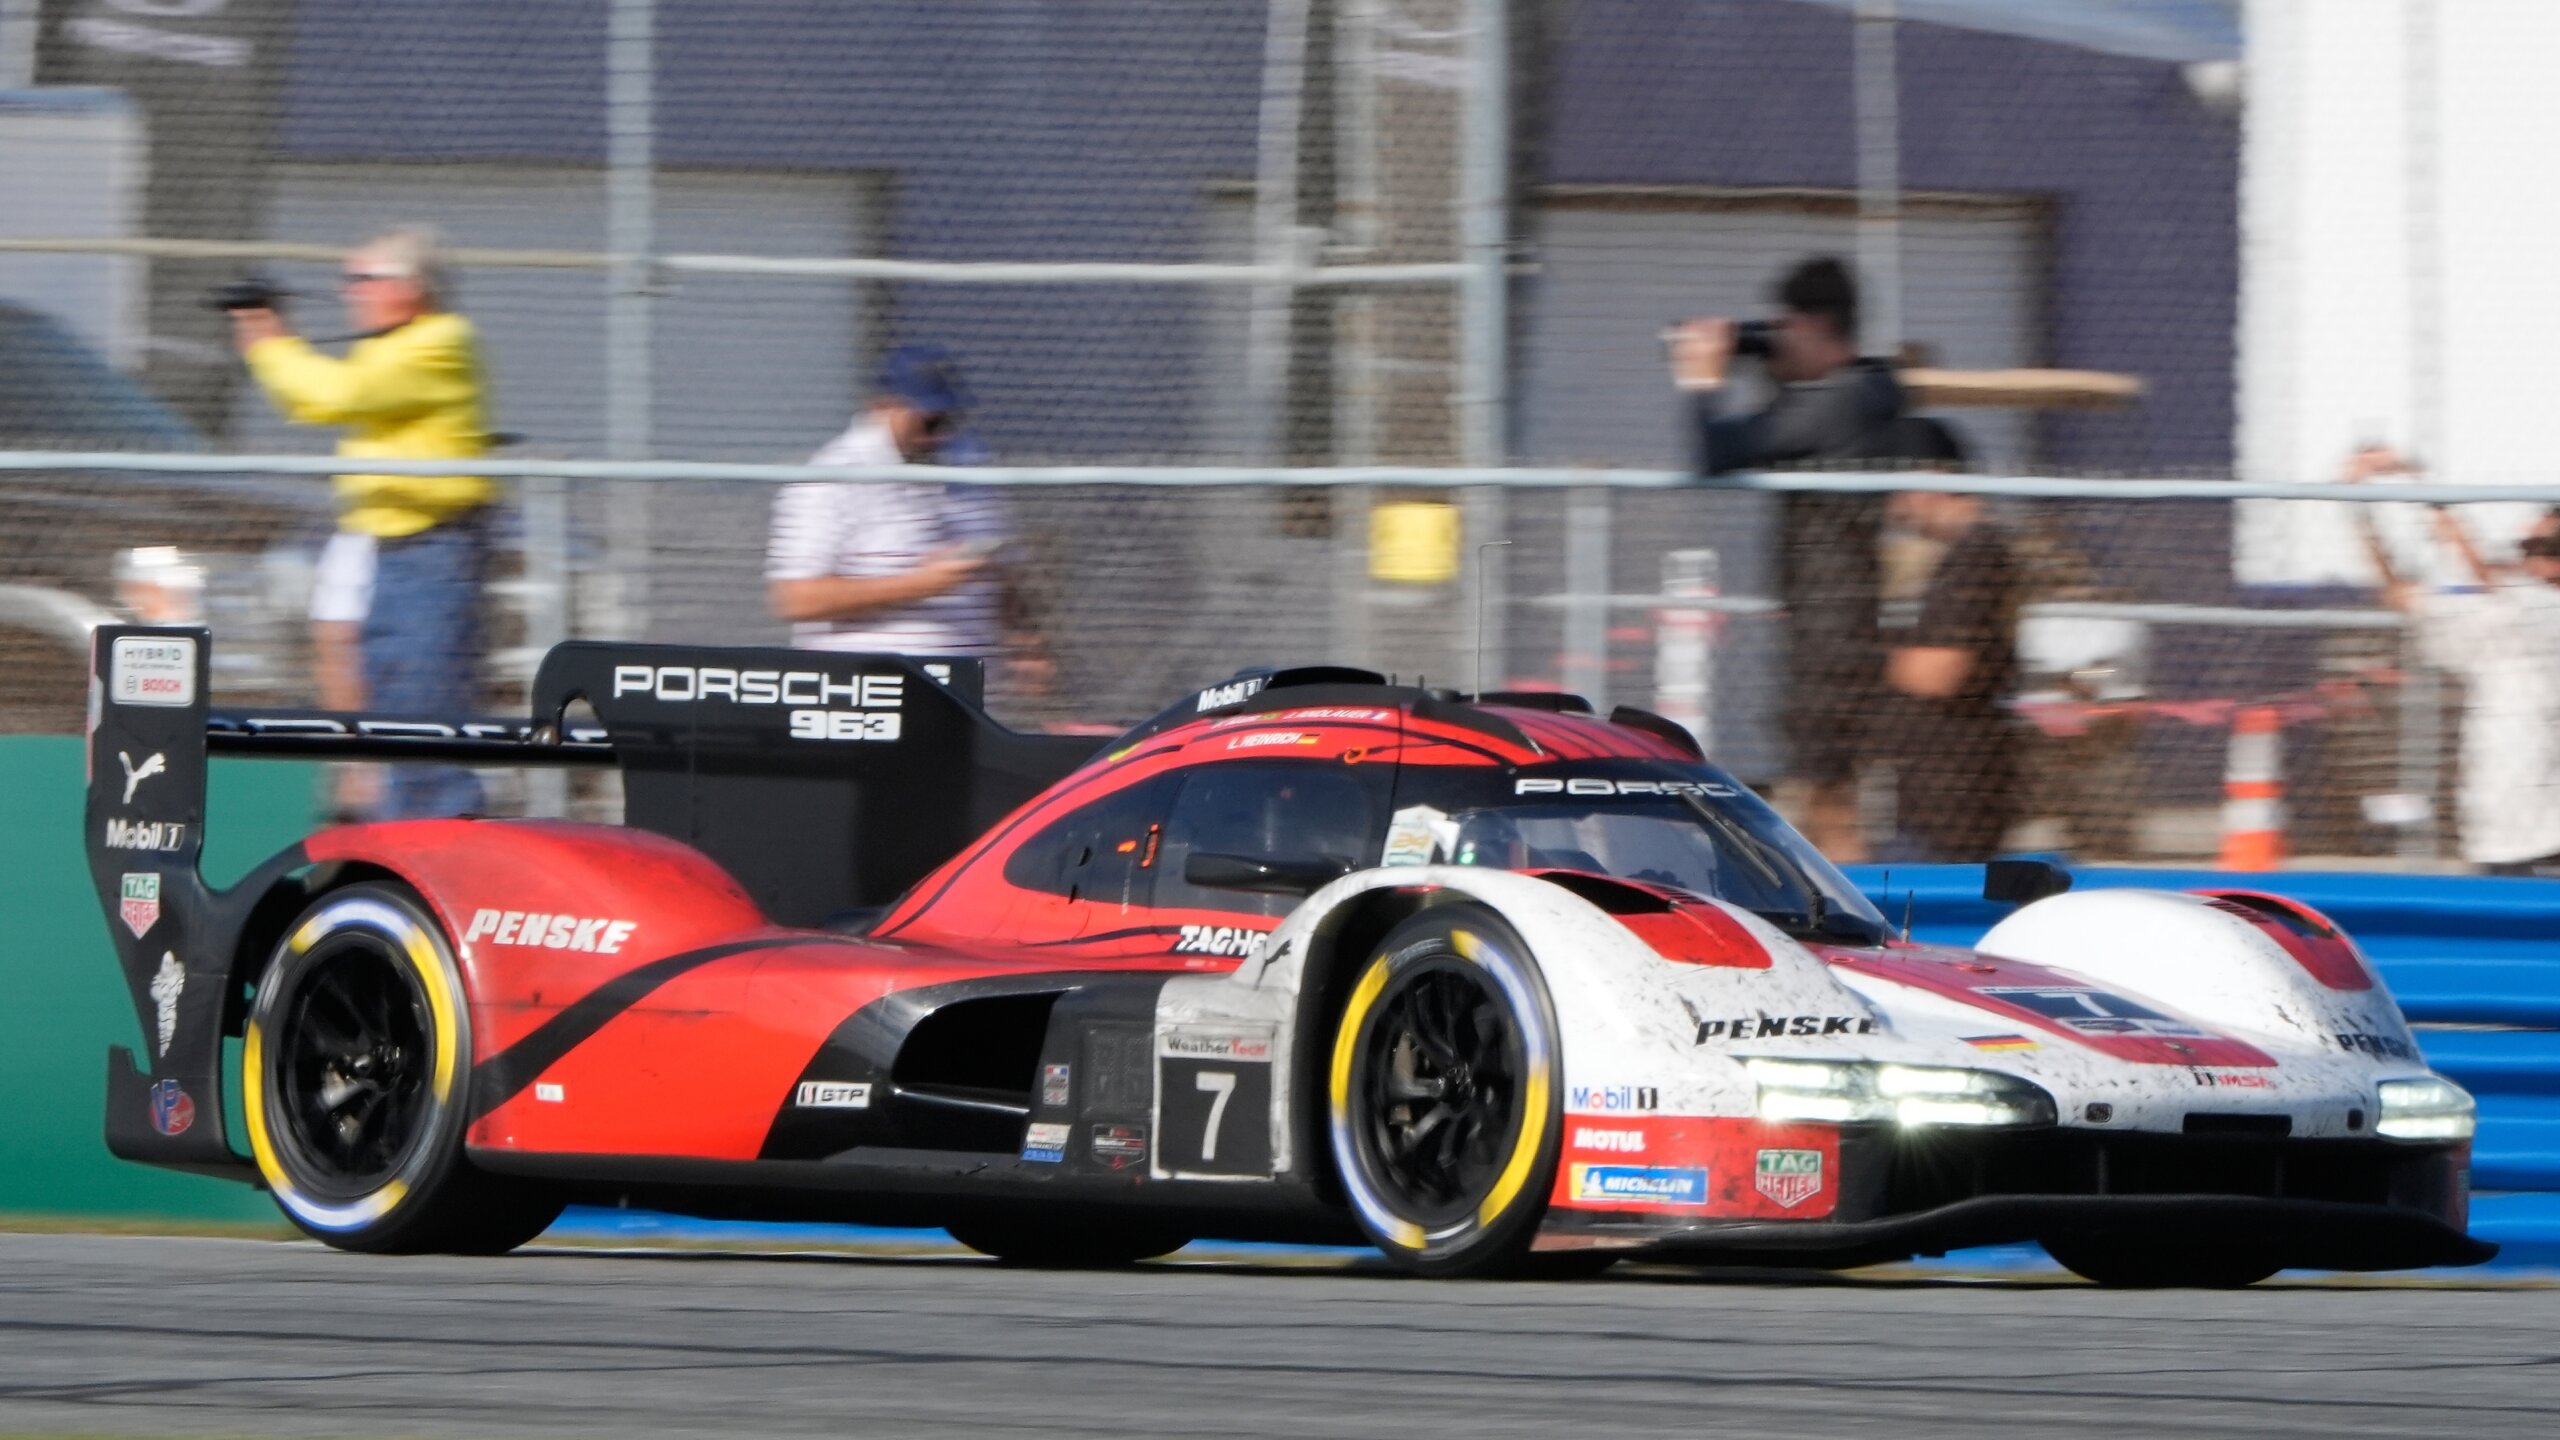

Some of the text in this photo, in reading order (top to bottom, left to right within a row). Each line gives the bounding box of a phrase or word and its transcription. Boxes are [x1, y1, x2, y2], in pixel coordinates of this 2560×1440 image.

[143, 679, 182, 693] BOSCH
[613, 665, 904, 707] PORSCHE
[1196, 682, 1246, 712] Mobil
[789, 710, 901, 740] 963
[1514, 778, 1744, 797] PORSC
[104, 818, 163, 850] Mobil
[124, 878, 158, 899] TAG
[463, 908, 639, 954] PENSKE
[1695, 1015, 1881, 1046] PENSKE
[820, 1088, 865, 1102] GTP
[1572, 1086, 1631, 1109] Mobil
[1195, 1071, 1237, 1161] 7
[1573, 1127, 1647, 1153] MOTUL
[1763, 1152, 1818, 1173] TAG
[1603, 1176, 1694, 1195] MICHELIN
[1760, 1173, 1818, 1202] HEUER
